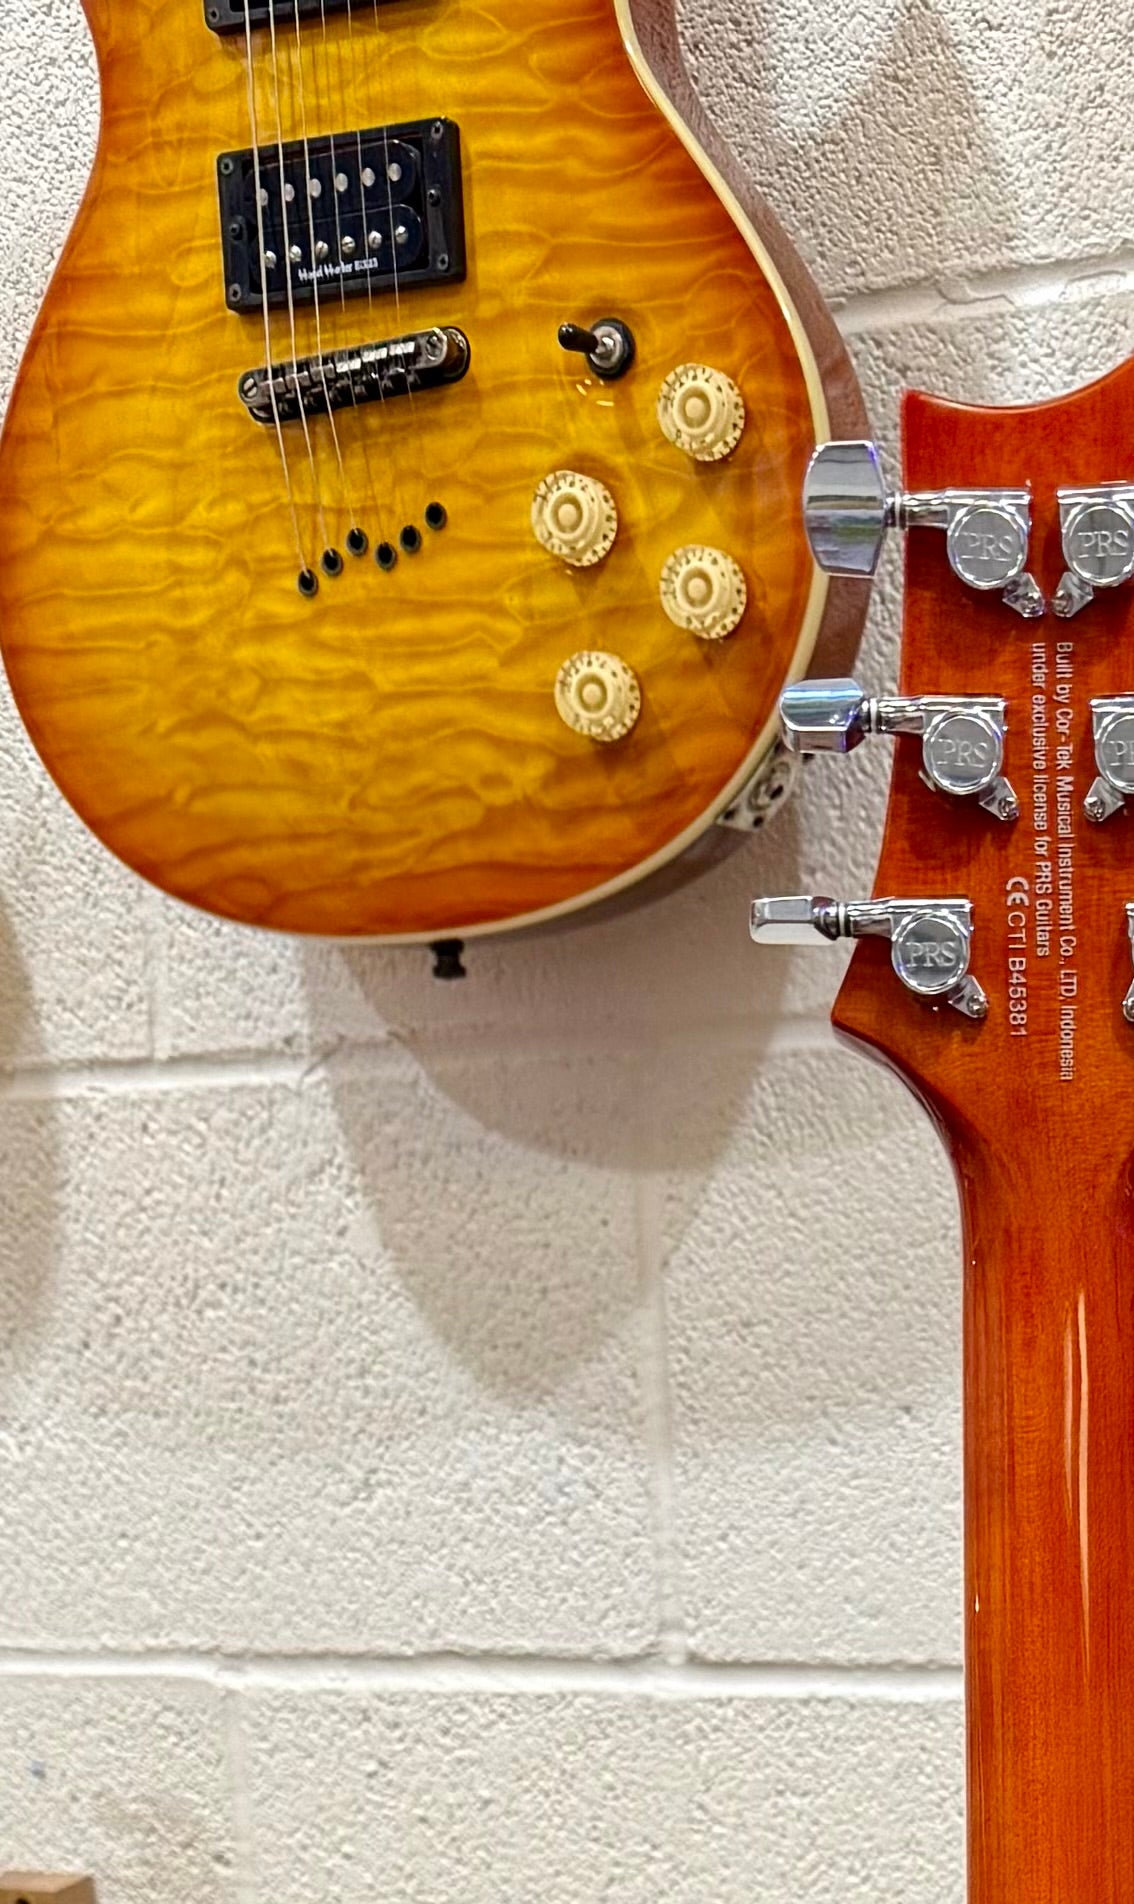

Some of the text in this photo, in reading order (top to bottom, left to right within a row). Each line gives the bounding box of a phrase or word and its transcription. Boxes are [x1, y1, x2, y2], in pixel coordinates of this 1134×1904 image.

[961, 531, 1013, 562] PRS
[1077, 530, 1129, 558] PRS
[936, 738, 988, 768] PRS
[1032, 642, 1053, 957] under exclusive license for PRS Guitars
[1053, 641, 1078, 1081] Built by Cor-Tek Musical Instrument Co., LTD, Indonesia
[906, 941, 957, 967] PRS
